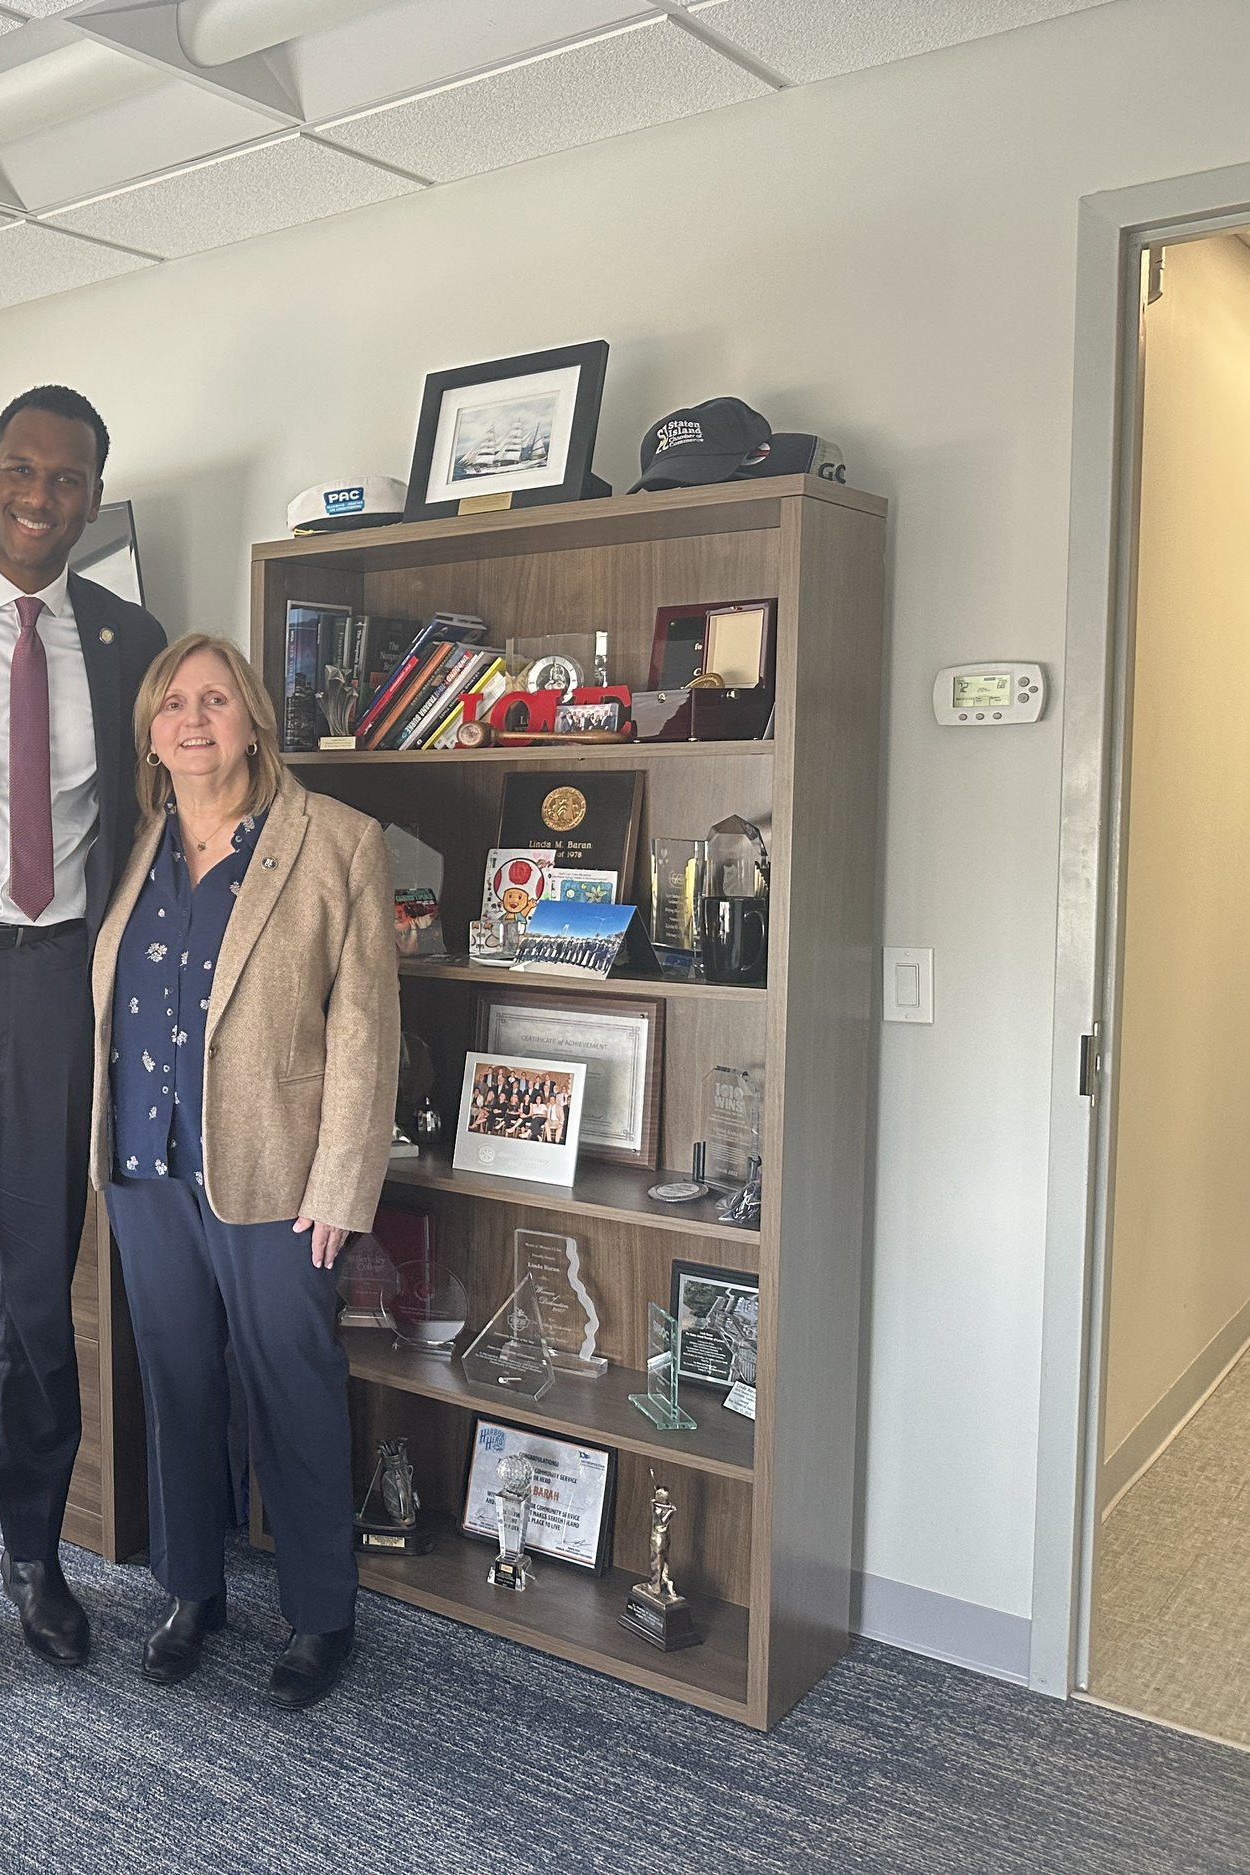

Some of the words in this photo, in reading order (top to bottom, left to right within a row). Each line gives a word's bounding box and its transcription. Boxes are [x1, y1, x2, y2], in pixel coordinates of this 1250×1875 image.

[668, 420, 701, 430] Staten
[668, 426, 702, 437] Island
[669, 434, 695, 442] Chamber
[669, 438, 704, 447] Commerce
[328, 490, 360, 503] PAC
[445, 653, 469, 684] UNBOUND
[957, 682, 969, 693] 72
[417, 694, 438, 718] TARANA
[404, 713, 422, 735] BURKE
[529, 840, 551, 849] Linda
[555, 840, 564, 849] M.
[567, 841, 592, 849] Baran
[566, 851, 583, 859] 1978
[520, 1034, 556, 1044] CERTIFICATE
[565, 1038, 608, 1050] ACHIEVEMENT
[714, 1096, 744, 1112] WINS
[480, 1428, 505, 1443] HARBOR
[485, 1436, 504, 1450] HERO
[534, 1467, 559, 1479] COMMUNITY
[559, 1474, 578, 1484] SERVICE
[531, 1517, 545, 1526] PLACE
[550, 1523, 561, 1531] LIVE
